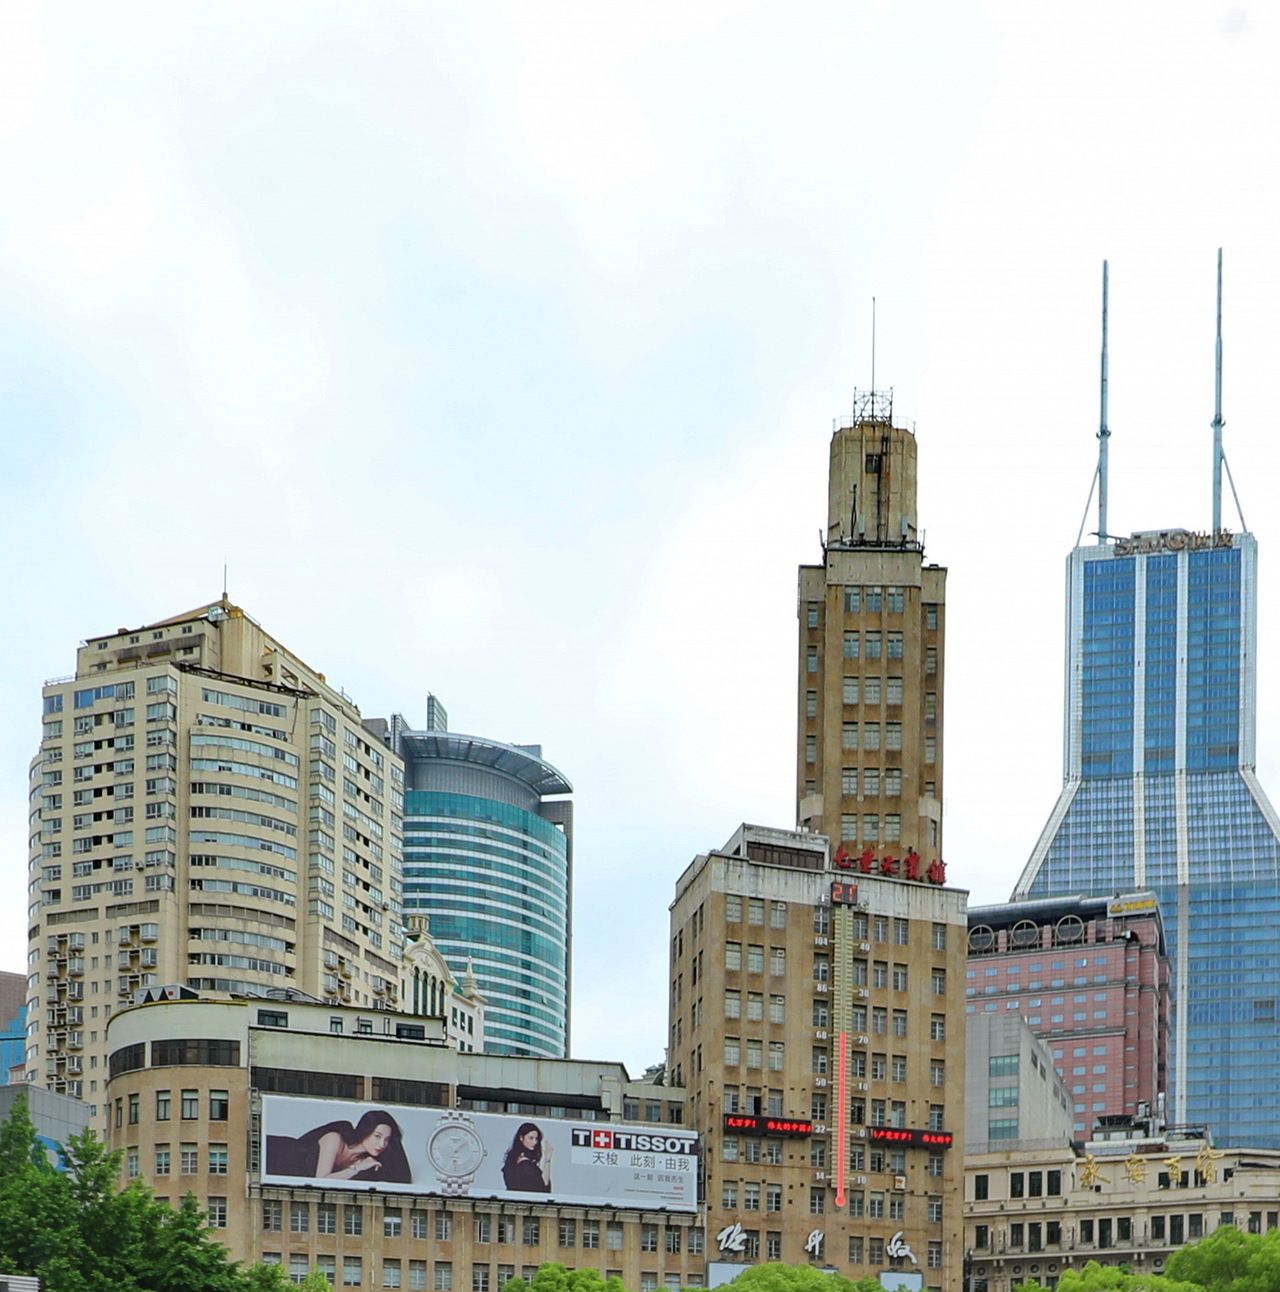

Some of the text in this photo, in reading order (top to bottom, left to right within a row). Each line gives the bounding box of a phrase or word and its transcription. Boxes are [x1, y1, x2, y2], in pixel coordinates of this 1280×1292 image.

[815, 1125, 826, 1133] 32
[615, 1133, 696, 1154] TISSOT
[592, 1151, 619, 1166] 天梭
